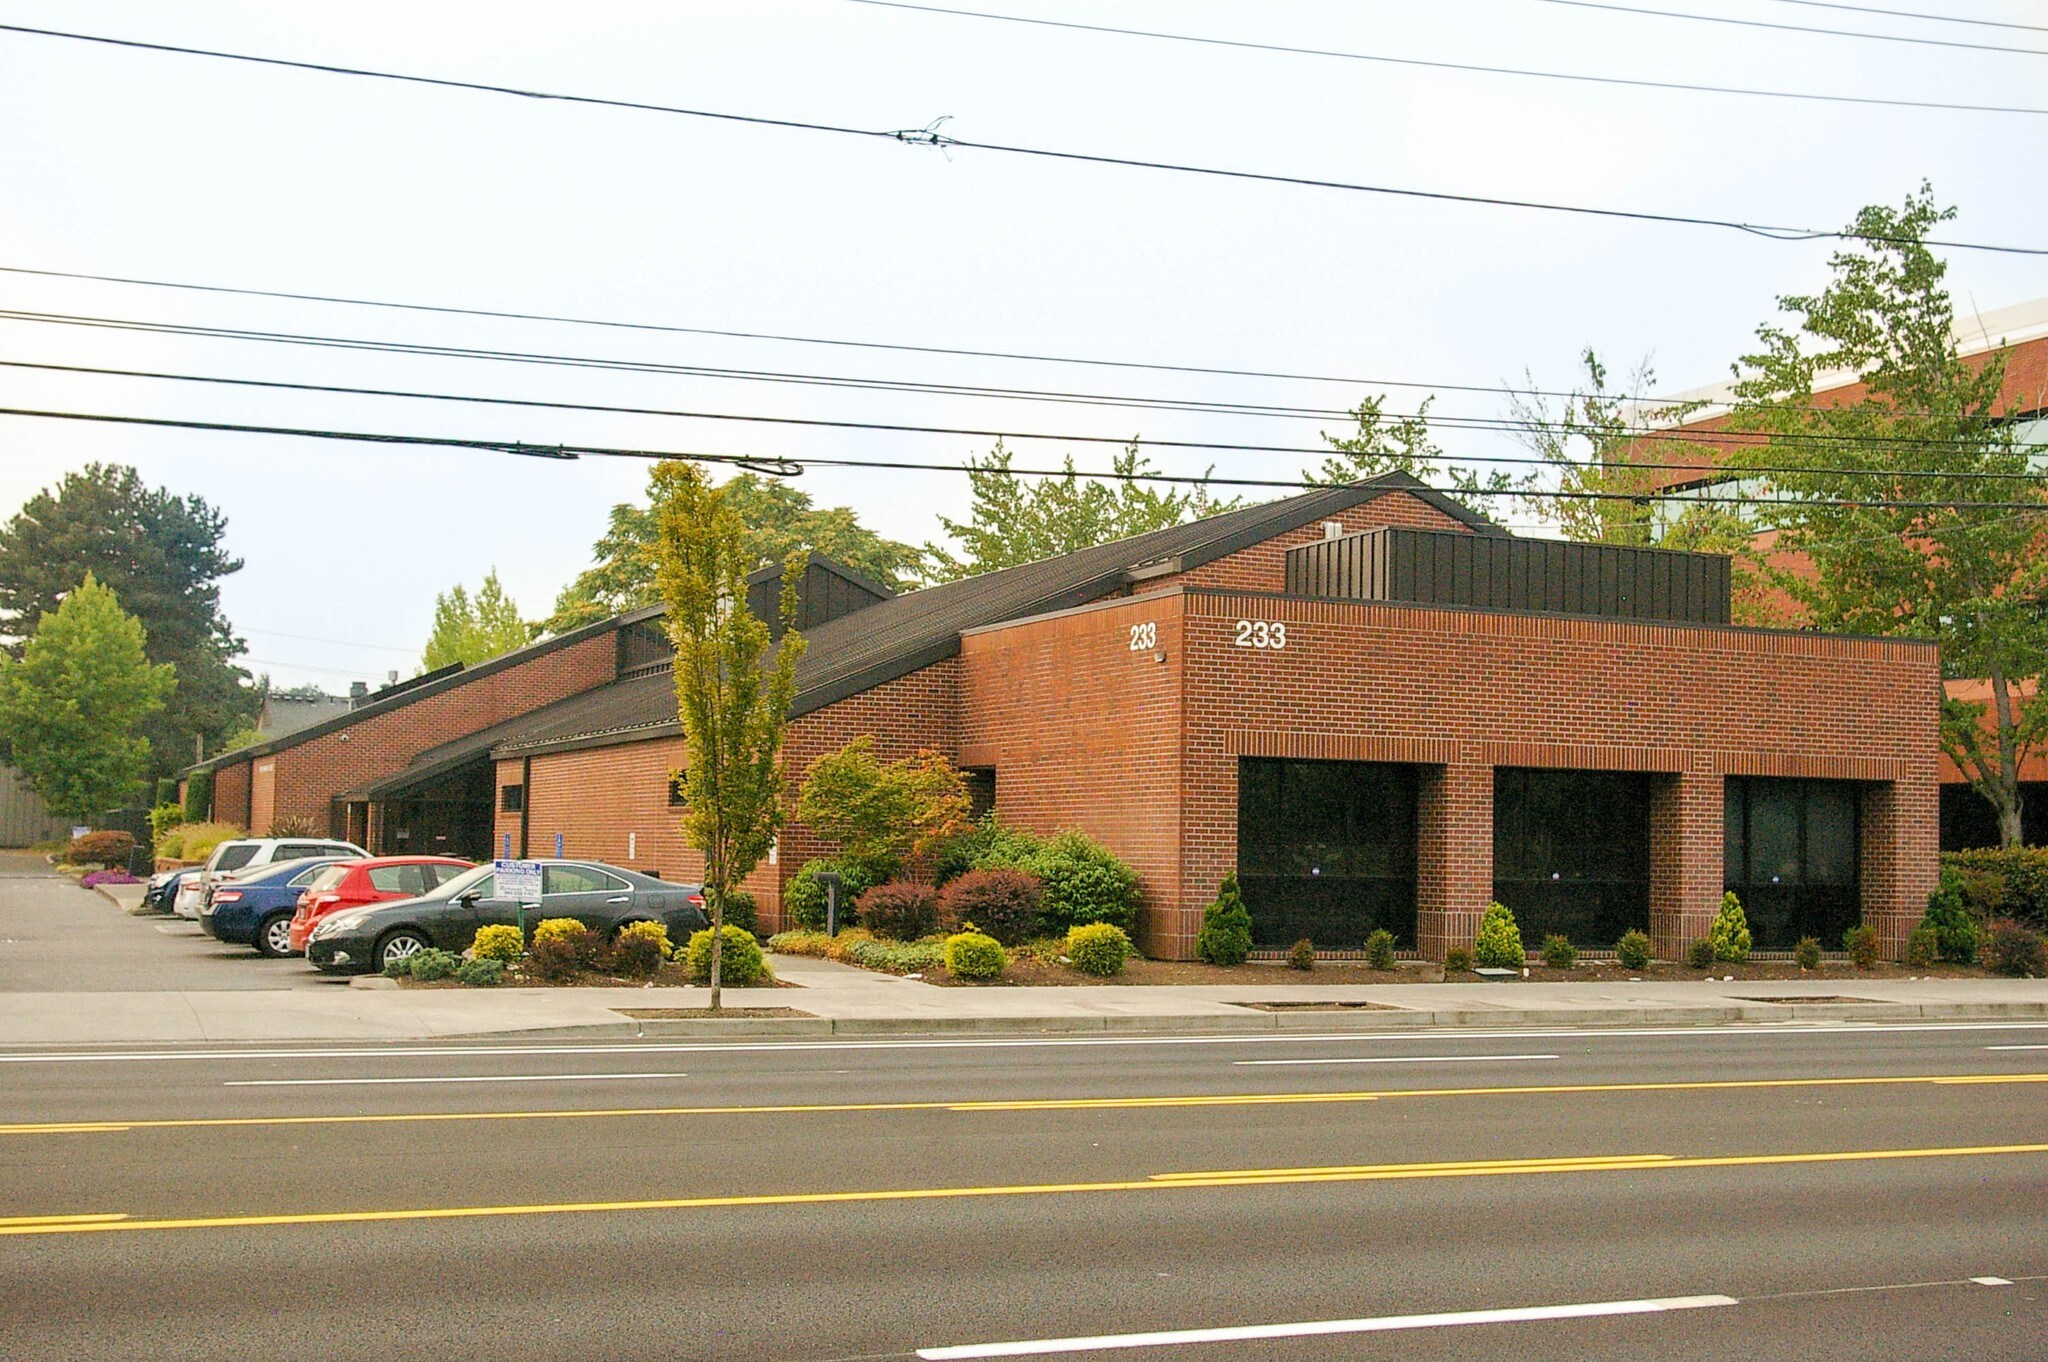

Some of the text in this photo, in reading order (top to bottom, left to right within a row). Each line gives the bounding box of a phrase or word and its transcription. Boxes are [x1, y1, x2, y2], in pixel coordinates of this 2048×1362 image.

[1129, 622, 1157, 651] 233
[1235, 620, 1287, 649] 233
[500, 861, 537, 870] CUSTOMER
[525, 868, 541, 876] ONLY
